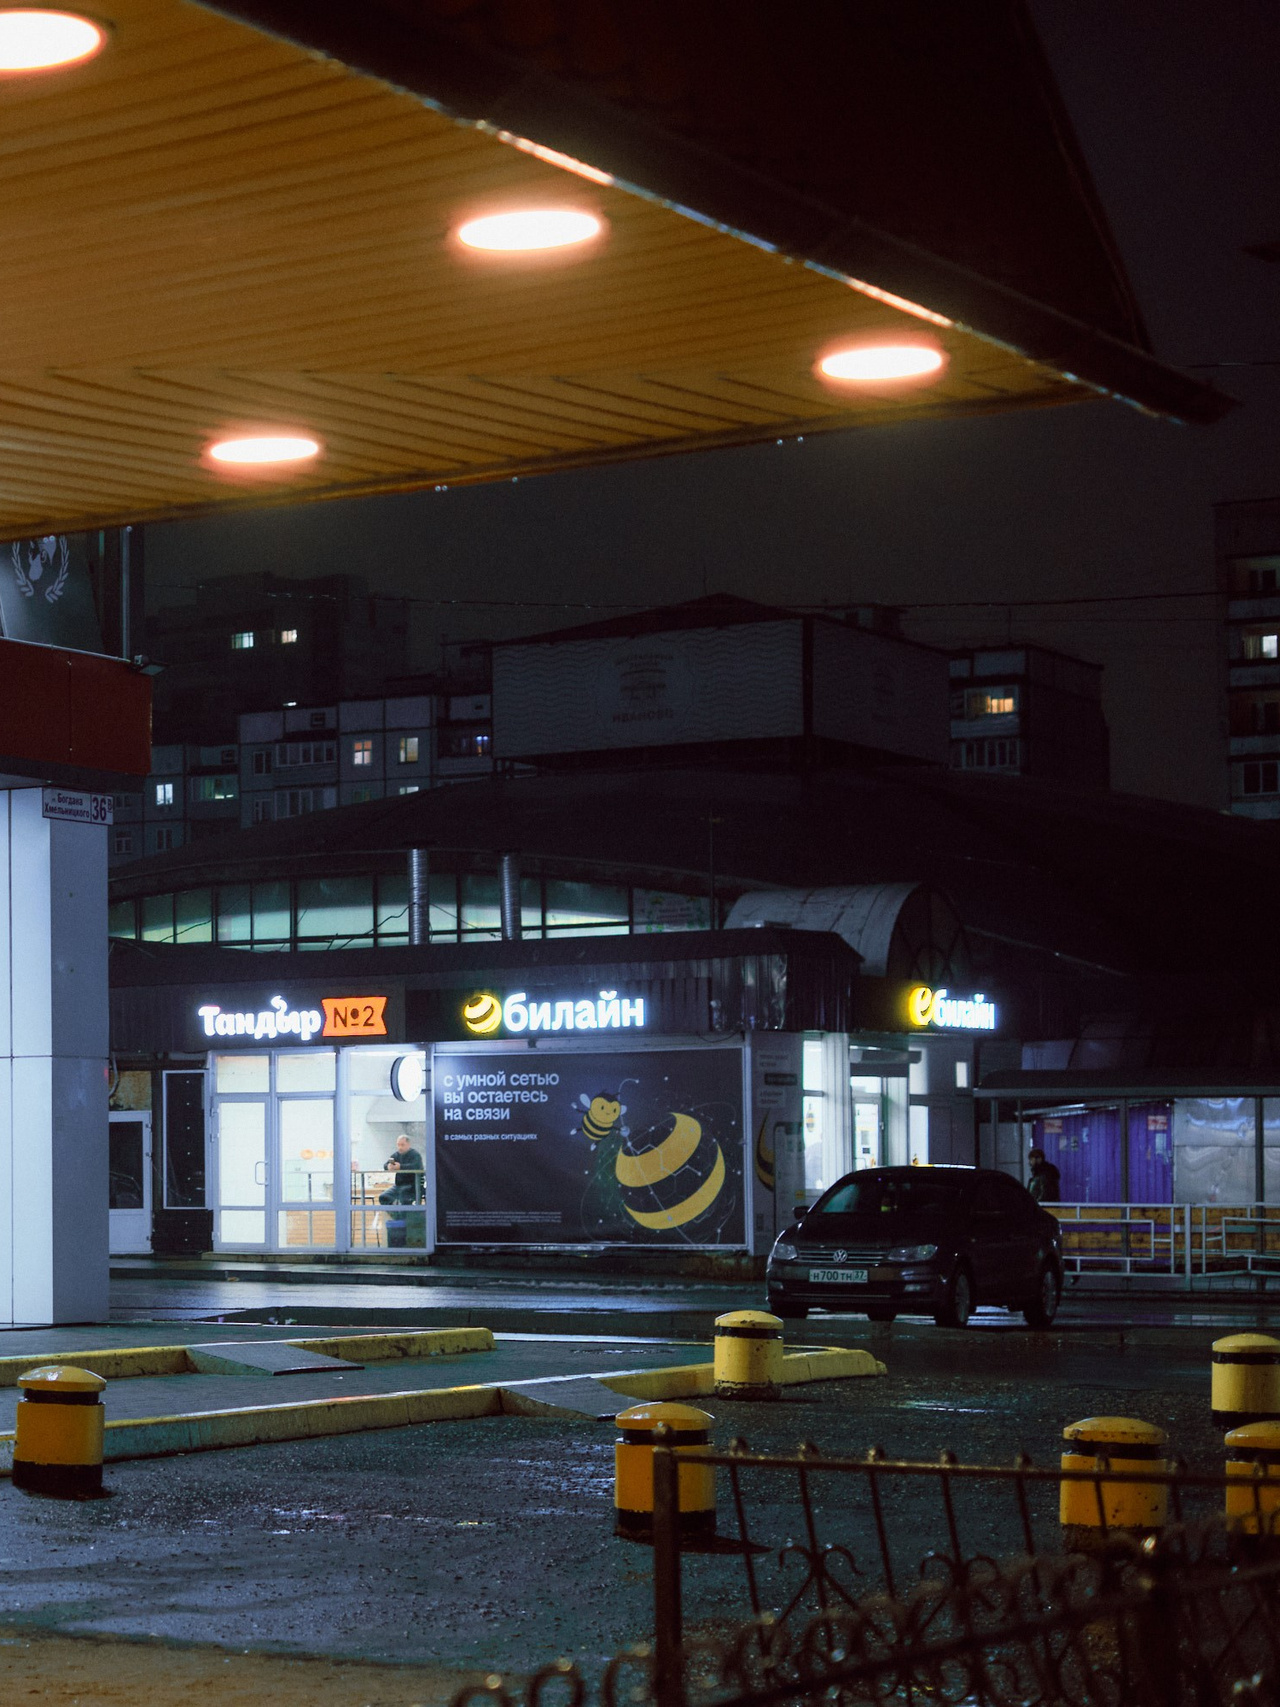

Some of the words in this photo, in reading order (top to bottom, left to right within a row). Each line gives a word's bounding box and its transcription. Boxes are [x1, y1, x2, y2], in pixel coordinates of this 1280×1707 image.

[57, 793, 83, 806] Богдана
[45, 802, 90, 818] Хмельницкого
[504, 991, 644, 1032] билайн
[933, 988, 995, 1029] билайн
[198, 995, 321, 1040] Тандыр
[443, 1075, 454, 1087] с
[456, 1071, 506, 1090] умной
[510, 1073, 560, 1086] сетью
[443, 1091, 464, 1103] вы
[467, 1090, 548, 1103] остаетесь
[443, 1108, 462, 1120] на
[466, 1108, 510, 1120] связи
[474, 1134, 500, 1142] разных
[501, 1133, 538, 1142] ситуациях
